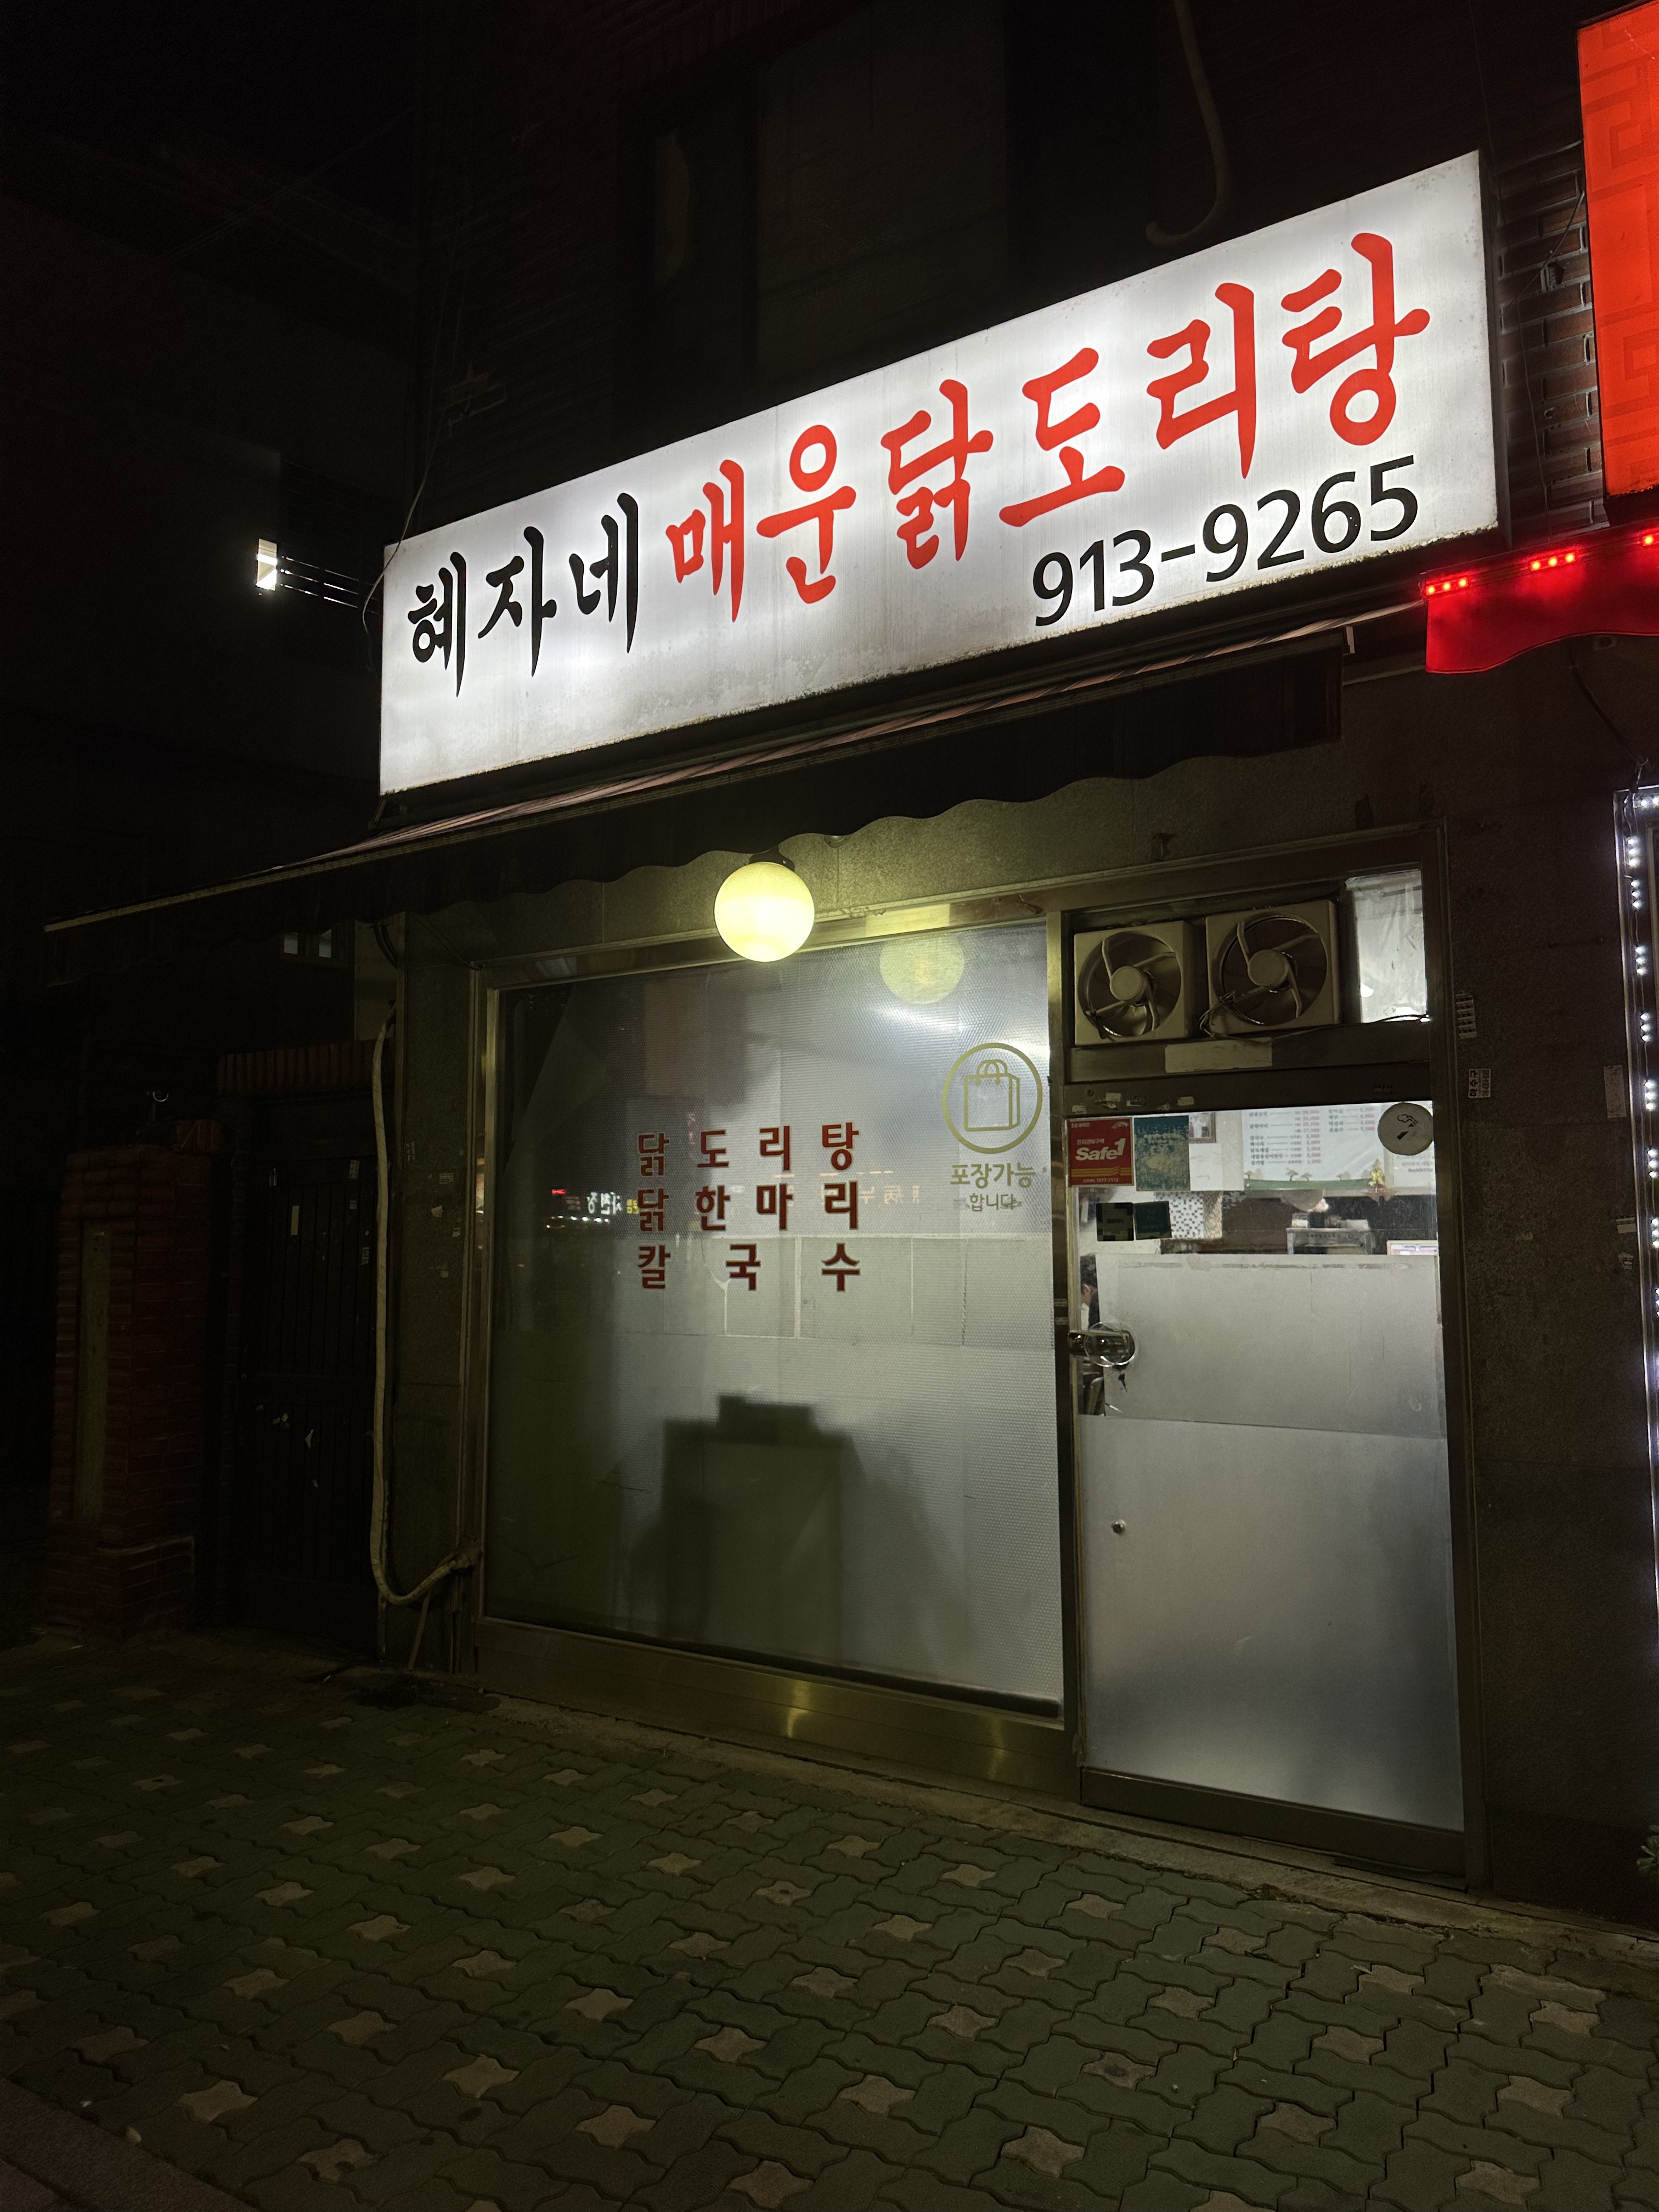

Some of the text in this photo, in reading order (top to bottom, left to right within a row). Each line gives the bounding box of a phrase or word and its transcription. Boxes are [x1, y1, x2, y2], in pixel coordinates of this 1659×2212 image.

[408, 233, 1430, 697] 혜자네 매운 닭도리탕
[1032, 455, 1418, 627] 913-9265
[637, 1122, 860, 1177] 닭도리탕
[950, 1162, 1035, 1189] 포장가능
[637, 1181, 859, 1234] 닭한마리
[969, 1193, 1014, 1212] 합니다
[637, 1243, 860, 1292] 칼국수
